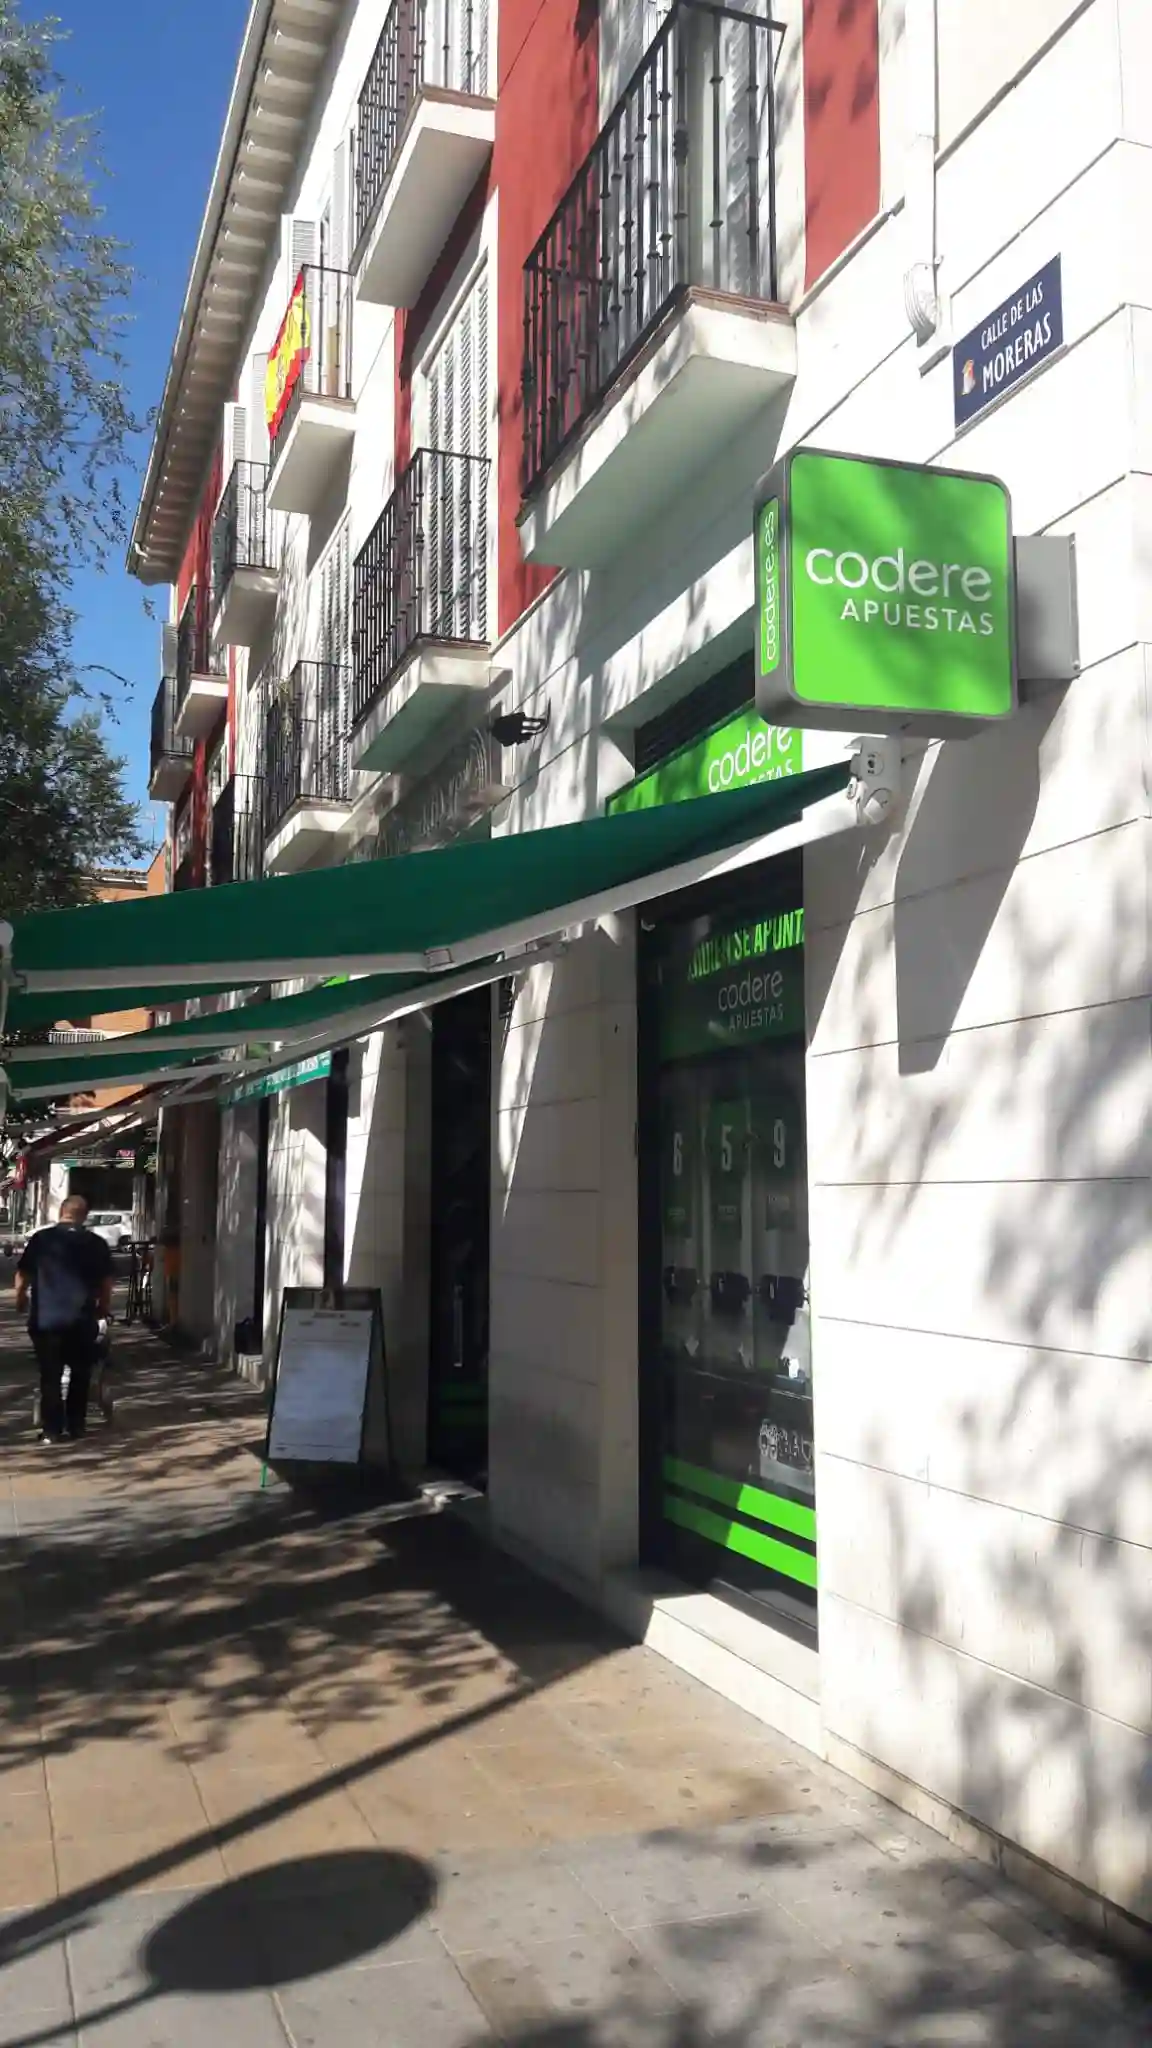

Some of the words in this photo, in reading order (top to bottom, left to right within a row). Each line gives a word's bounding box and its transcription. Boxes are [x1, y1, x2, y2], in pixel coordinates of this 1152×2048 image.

[981, 312, 1008, 351] CALLE
[1010, 299, 1023, 327] DE
[1026, 281, 1043, 313] LAS
[982, 312, 1052, 394] MORERAS
[764, 511, 776, 661] codere.es
[805, 547, 992, 602] codere
[840, 598, 994, 636] APUESTAS
[708, 726, 793, 793] codere
[754, 907, 805, 954] APUNT
[718, 970, 783, 1011] codere
[729, 1004, 783, 1034] APUESTAS
[721, 1124, 733, 1172] 5
[773, 1118, 785, 1169] 9
